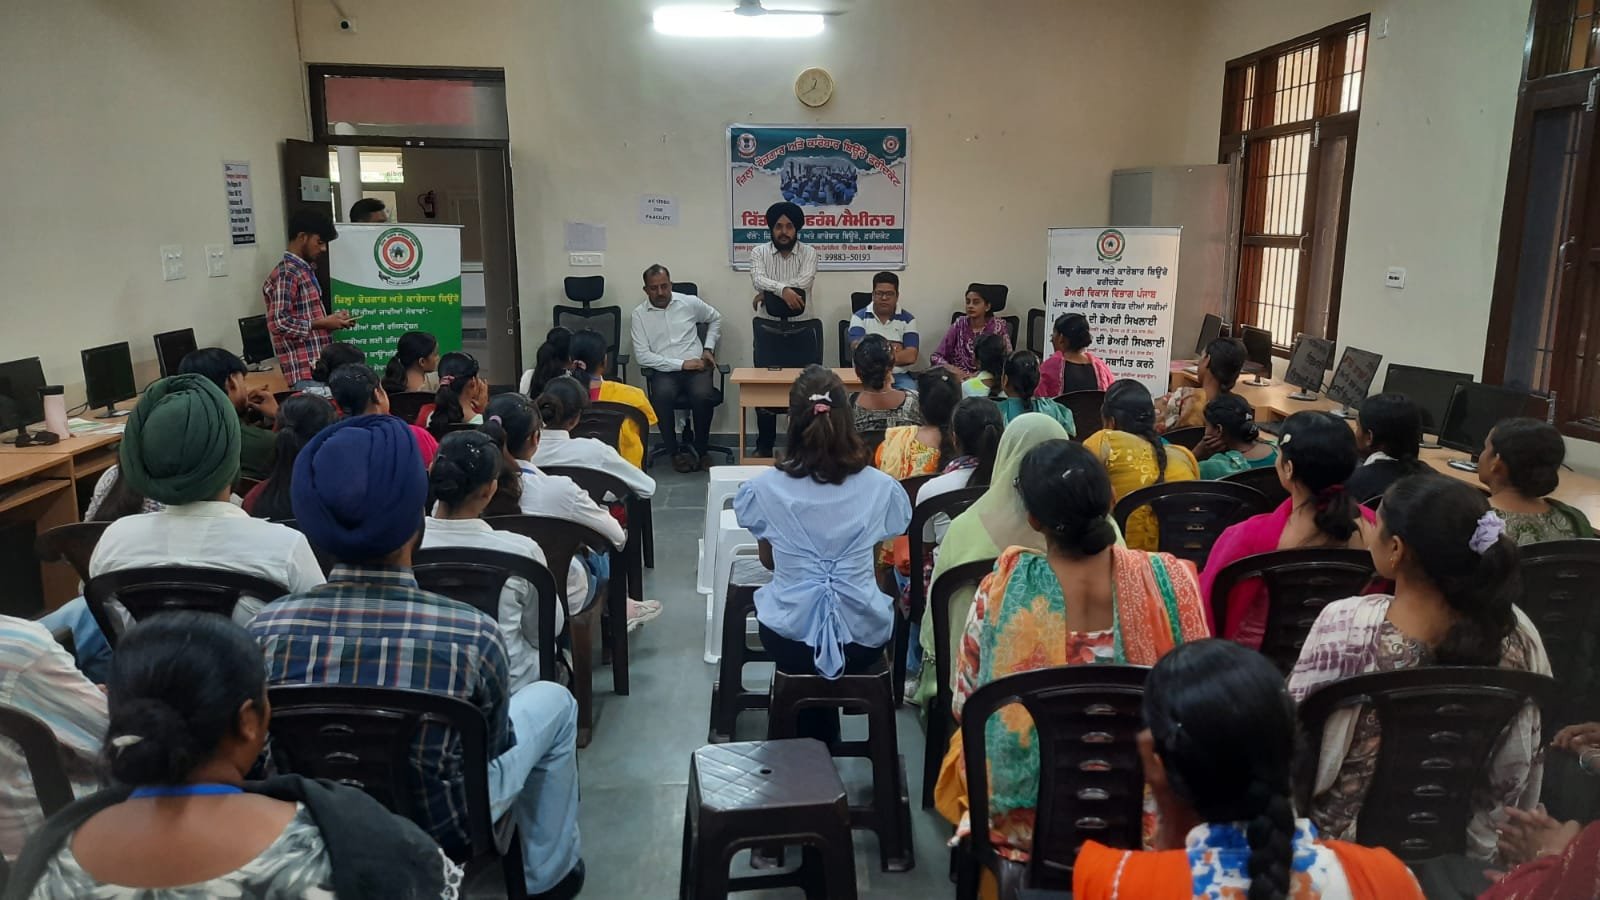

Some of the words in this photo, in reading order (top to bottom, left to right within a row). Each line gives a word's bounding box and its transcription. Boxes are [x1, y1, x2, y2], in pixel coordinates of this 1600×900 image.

[787, 137, 804, 151] ਅਤੇ
[806, 135, 841, 149] ਕਾਰੋਬਾਰ
[741, 210, 768, 227] ਕਿੱਤ
[824, 253, 871, 261] 99883-50193
[1102, 265, 1115, 275] ਅਤੇ
[1117, 265, 1145, 276] ਕਾਰੋਬਾਰ
[390, 293, 403, 303] ਅਤੇ
[406, 293, 436, 303] ਕਾਰੋਬਾਰ
[1063, 286, 1085, 297] ਡੇਅਰੀ
[1087, 286, 1109, 297] ਵਿਕਾਸ
[1111, 287, 1134, 298] ਵਿਭਾਗ
[1137, 287, 1157, 299] ਪੰਜਾਬ
[1053, 299, 1068, 308] ਪੰਜਾਬ
[1089, 313, 1097, 324] ਦੀ
[1100, 313, 1122, 325] ਡੇਅਰੀ
[1124, 314, 1158, 326] ਸਿਖਲਾਈ
[1096, 333, 1105, 345] ਦੀ
[1107, 334, 1129, 346] ਡੇਅਰੀ
[1131, 335, 1165, 348] ਸਿਖਲਾਈ
